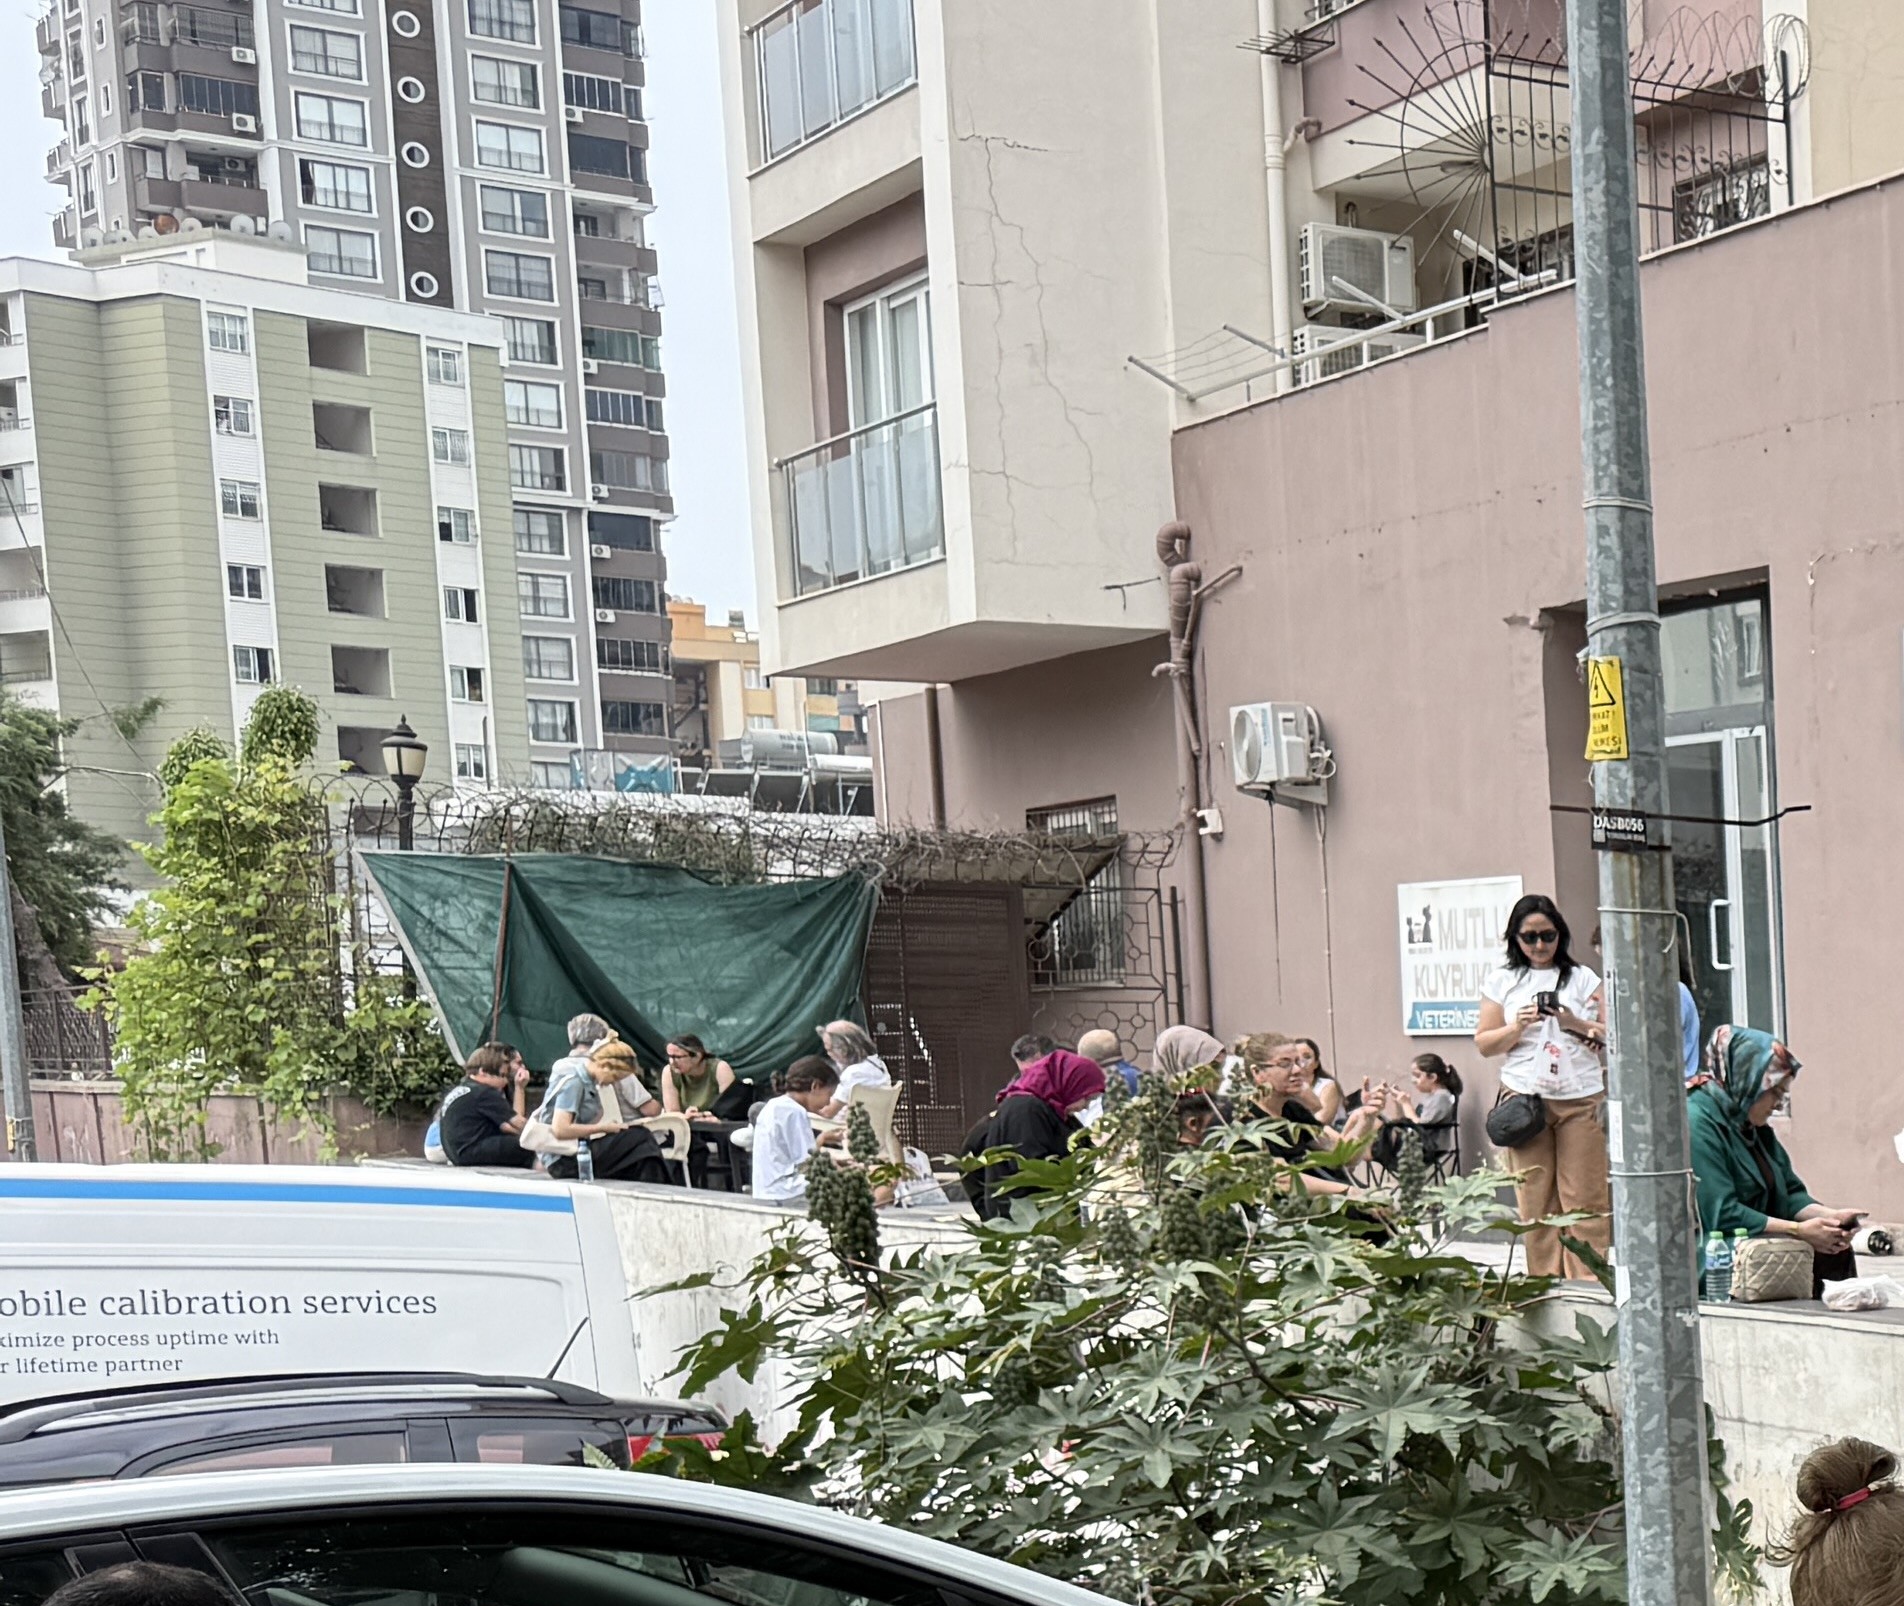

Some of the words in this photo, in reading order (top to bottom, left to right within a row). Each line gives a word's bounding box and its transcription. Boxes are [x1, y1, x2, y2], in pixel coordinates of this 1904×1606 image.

[1414, 962, 1492, 999] KUYRUK
[99, 1288, 292, 1317] calibration
[303, 1289, 438, 1315] services
[72, 1332, 150, 1352] process
[156, 1329, 229, 1350] uptime
[234, 1328, 280, 1345] with
[16, 1357, 98, 1374] lifetime
[105, 1356, 183, 1377] partner
